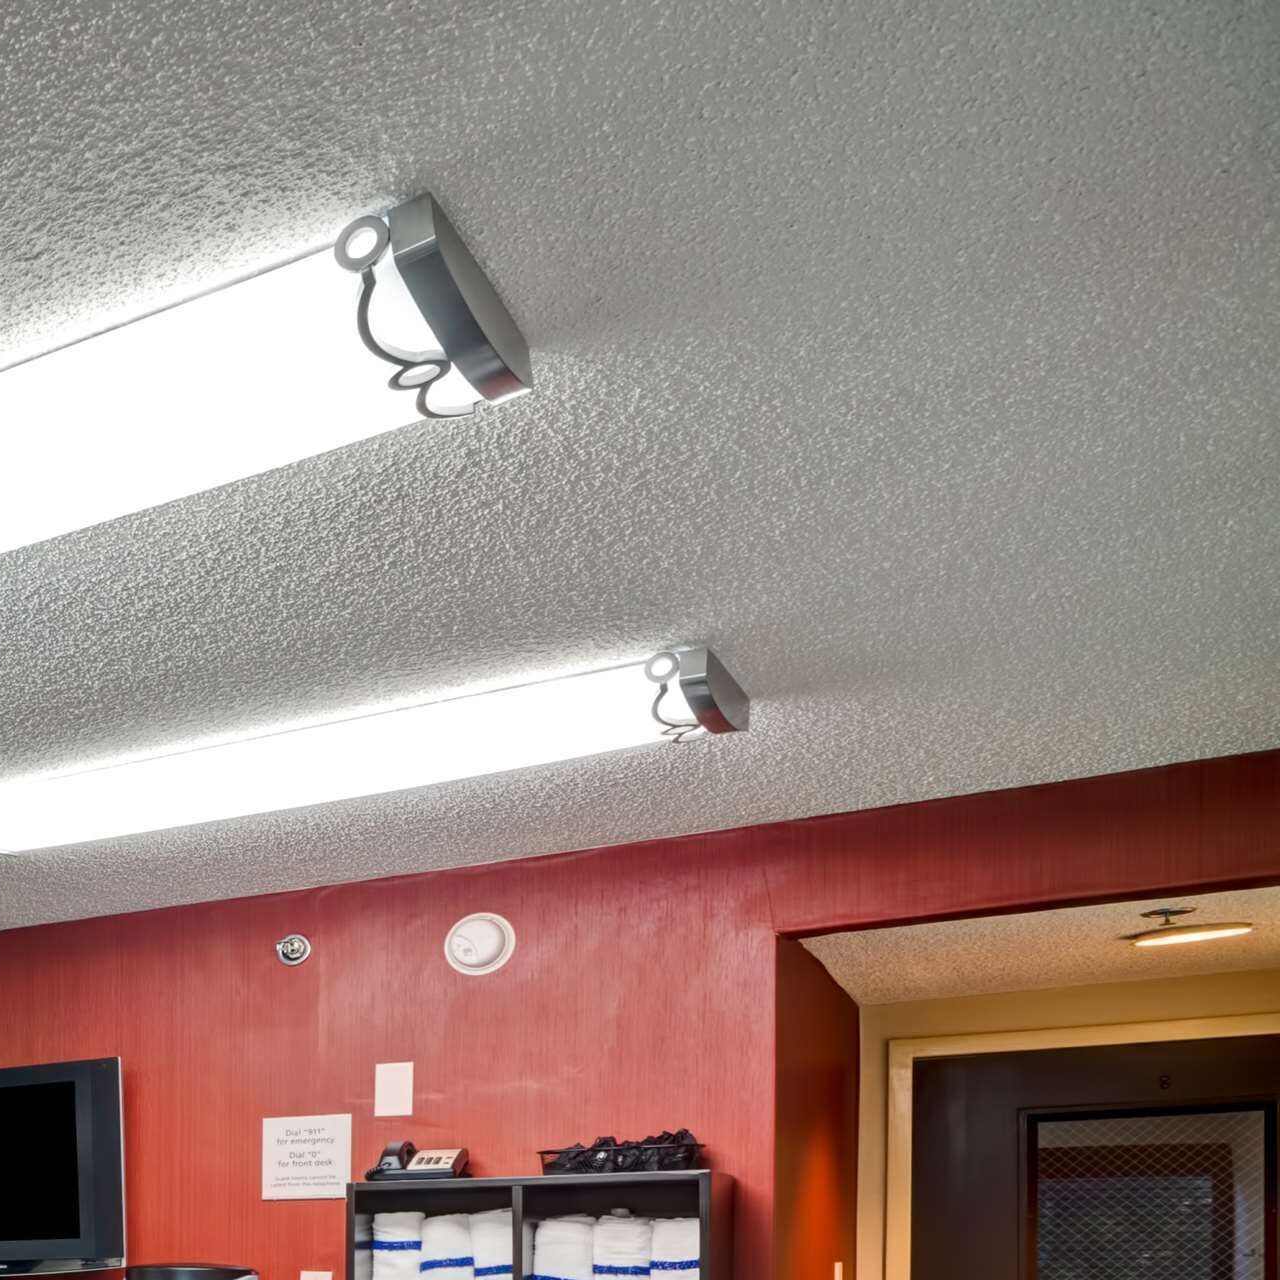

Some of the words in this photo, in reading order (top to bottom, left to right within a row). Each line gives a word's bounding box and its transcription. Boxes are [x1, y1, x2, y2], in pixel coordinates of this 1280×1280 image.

[285, 1128, 301, 1136] Dial
[290, 1137, 335, 1145] emergency
[278, 1160, 289, 1168] for
[292, 1160, 312, 1168] front
[314, 1159, 332, 1167] desk
